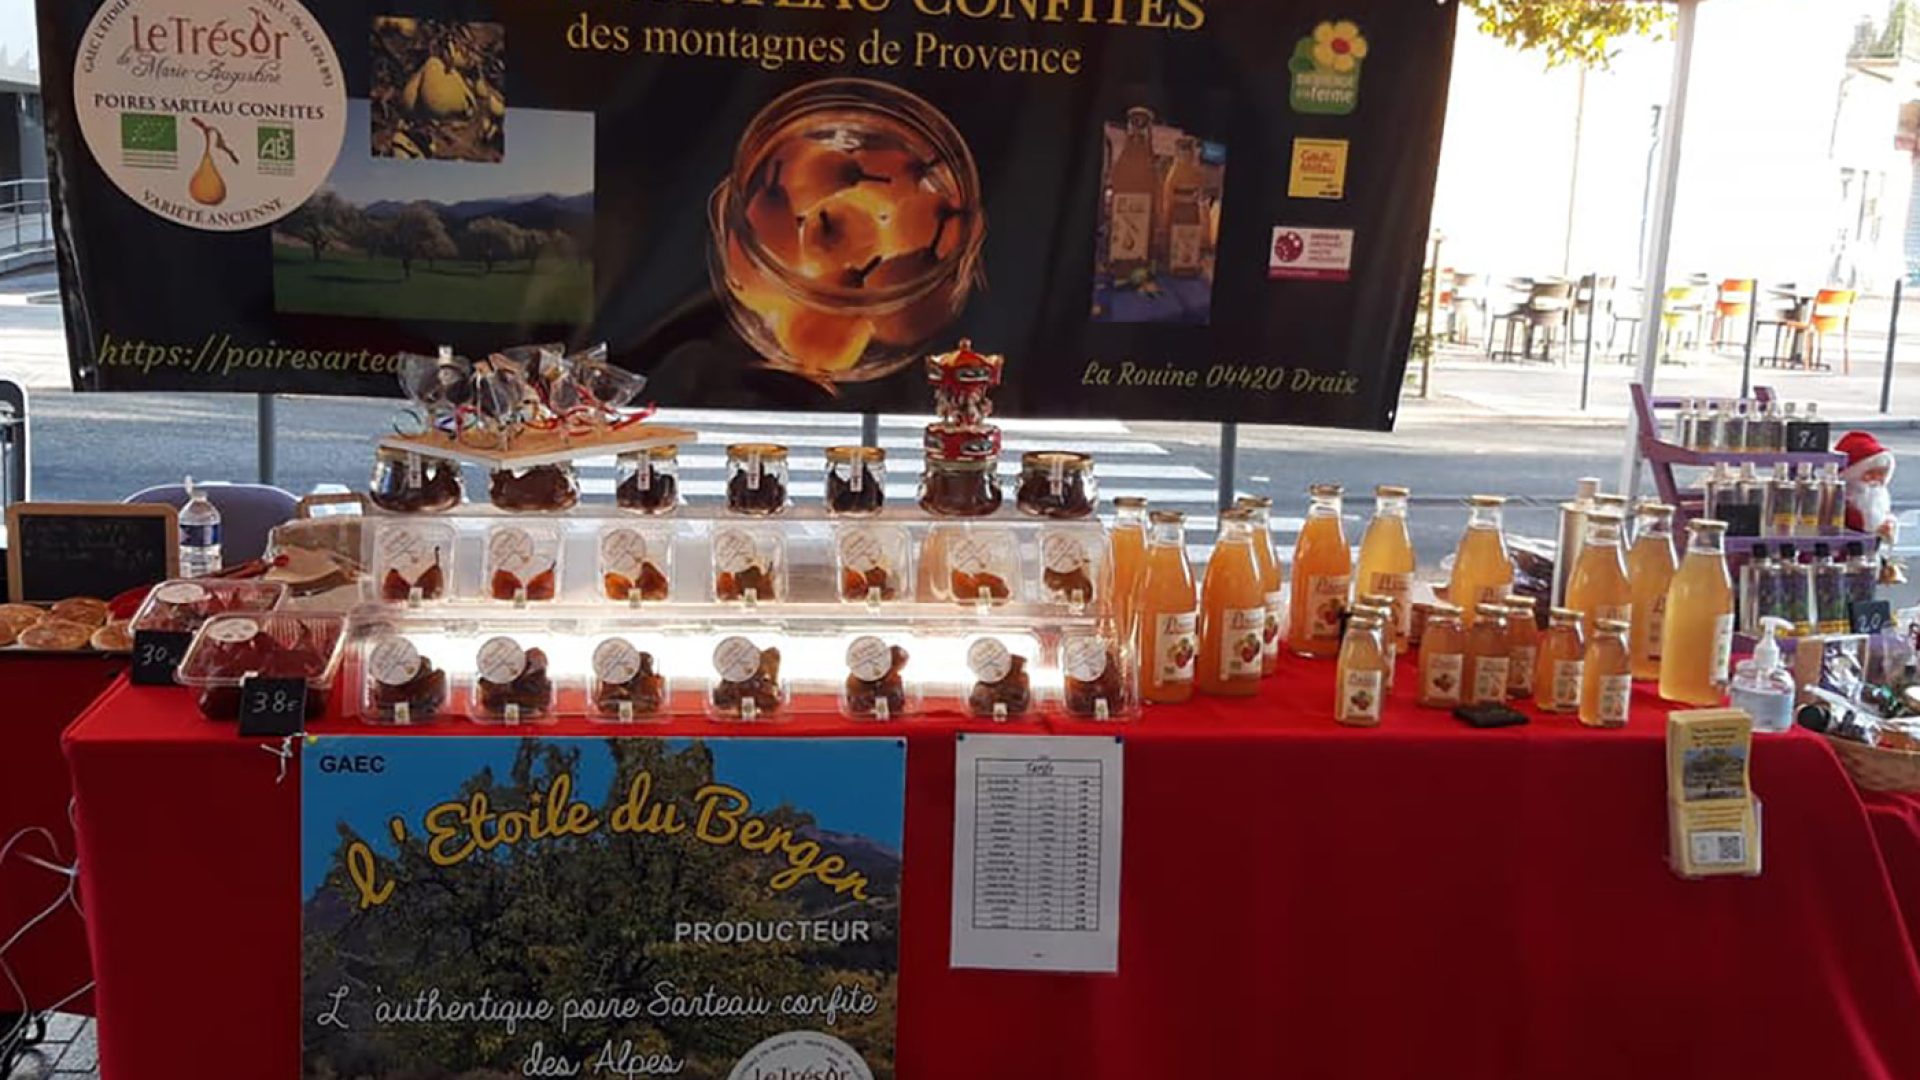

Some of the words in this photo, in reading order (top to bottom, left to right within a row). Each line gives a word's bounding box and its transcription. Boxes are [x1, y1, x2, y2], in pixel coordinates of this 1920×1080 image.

[567, 11, 629, 51] des
[643, 24, 846, 70] montagnes
[858, 28, 900, 65] de
[914, 31, 1083, 74] Provence
[94, 93, 156, 112] POIRES
[162, 98, 233, 116] SARTEAU
[238, 100, 325, 120] CONFITES
[1081, 360, 1110, 386] La
[1116, 361, 1199, 388] Rouine
[1205, 364, 1285, 391] 04420
[1289, 367, 1360, 395] Draix
[319, 755, 385, 774] GAEC
[610, 771, 686, 834] du
[695, 783, 869, 902] Berger
[675, 920, 870, 943] PRODUCTEUR
[561, 992, 640, 1034] poire
[780, 981, 878, 1026] confite
[522, 1039, 581, 1077] des
[592, 1037, 685, 1080] Alpes
